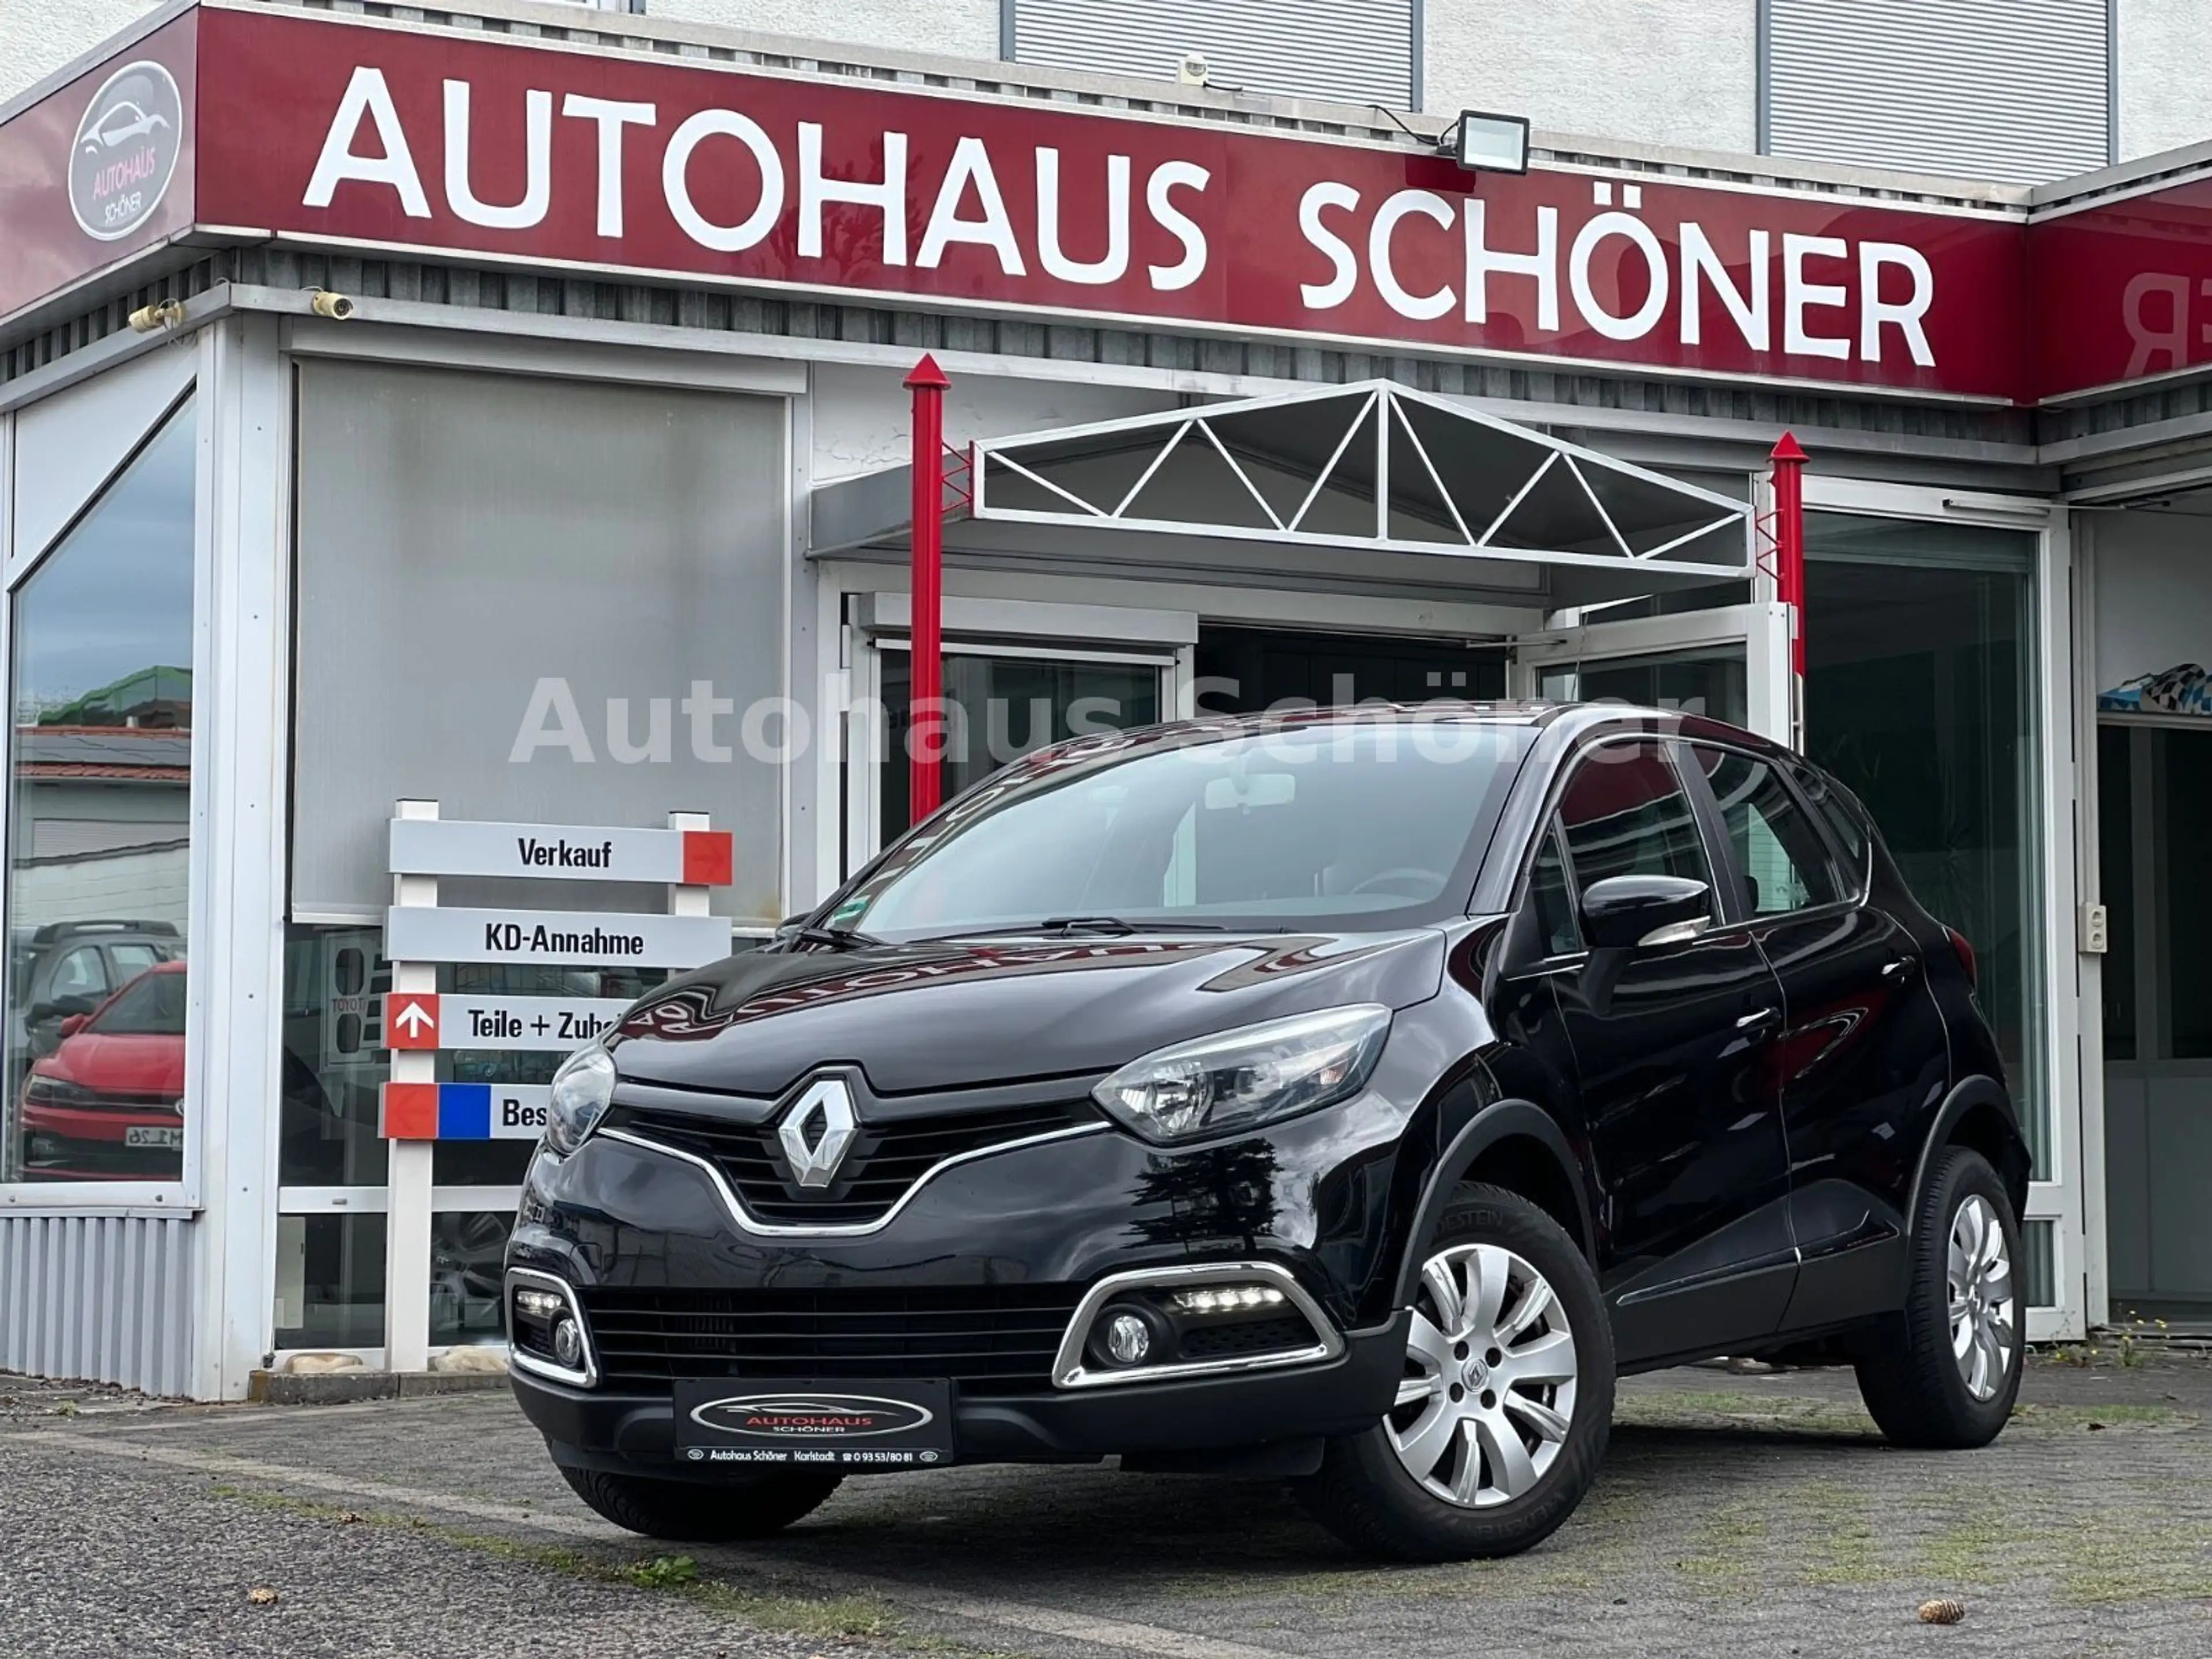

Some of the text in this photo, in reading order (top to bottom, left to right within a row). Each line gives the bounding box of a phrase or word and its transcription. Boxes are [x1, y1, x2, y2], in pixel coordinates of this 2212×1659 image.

[93, 146, 156, 200] AUTOHAUS
[302, 66, 1936, 366] AUTOHAUS SCHÖNER
[517, 838, 612, 868] Verkauf
[486, 923, 644, 955] KD-Annahme
[467, 1009, 522, 1037] Teile
[502, 1099, 547, 1126] Bes
[746, 1416, 873, 1425] AUTOHAUS
[772, 1425, 846, 1433] SCHÖNER
[710, 1449, 752, 1461] Autohaus
[753, 1449, 788, 1461] Schöner
[794, 1450, 835, 1461] Karlstadt
